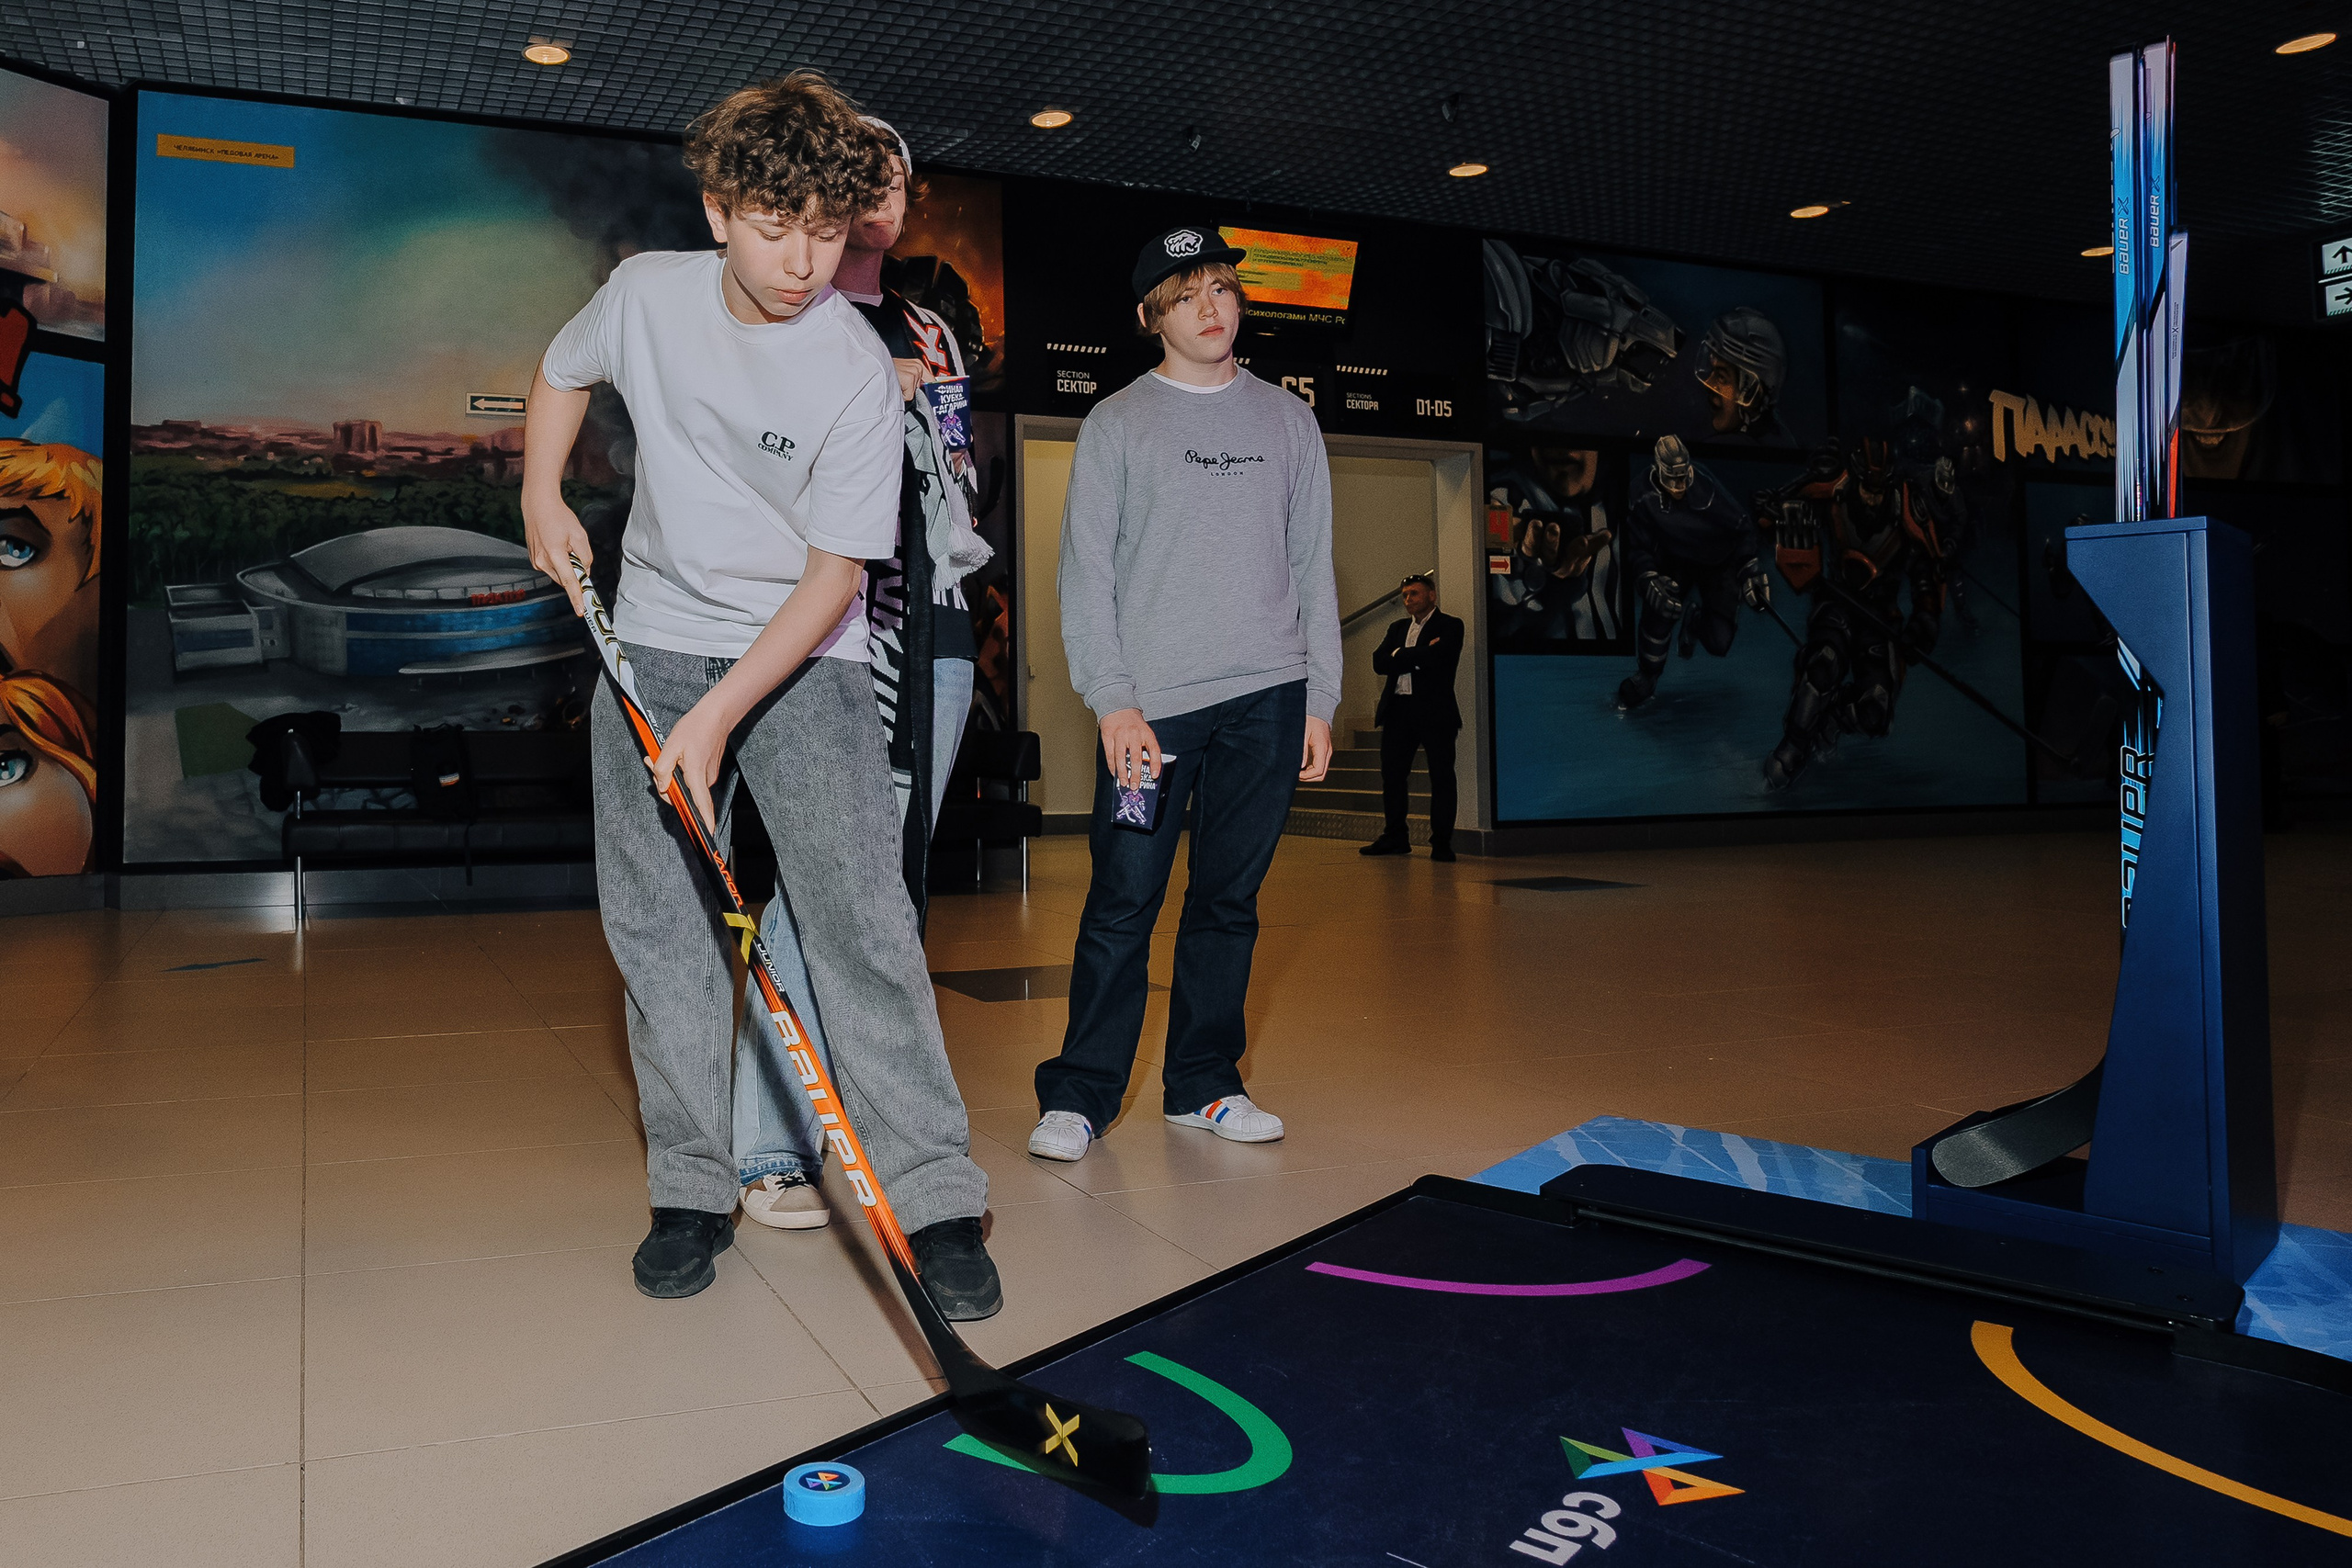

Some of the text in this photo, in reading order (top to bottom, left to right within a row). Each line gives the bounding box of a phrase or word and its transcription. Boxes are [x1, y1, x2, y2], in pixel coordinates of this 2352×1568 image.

[1308, 313, 1332, 323] МЧС
[1057, 369, 1091, 379] SECTION
[934, 384, 964, 395] ФИНАЛ
[1057, 378, 1097, 395] СЕКТОР
[940, 393, 965, 404] КУБКА
[1346, 392, 1373, 400] SECTIONS
[933, 399, 967, 416] ГАГАРИНА
[757, 443, 794, 461] COMPANY
[1185, 449, 1265, 470] Pepe Jeans
[713, 850, 743, 908] VAPOR
[757, 942, 786, 993] JUNIOR
